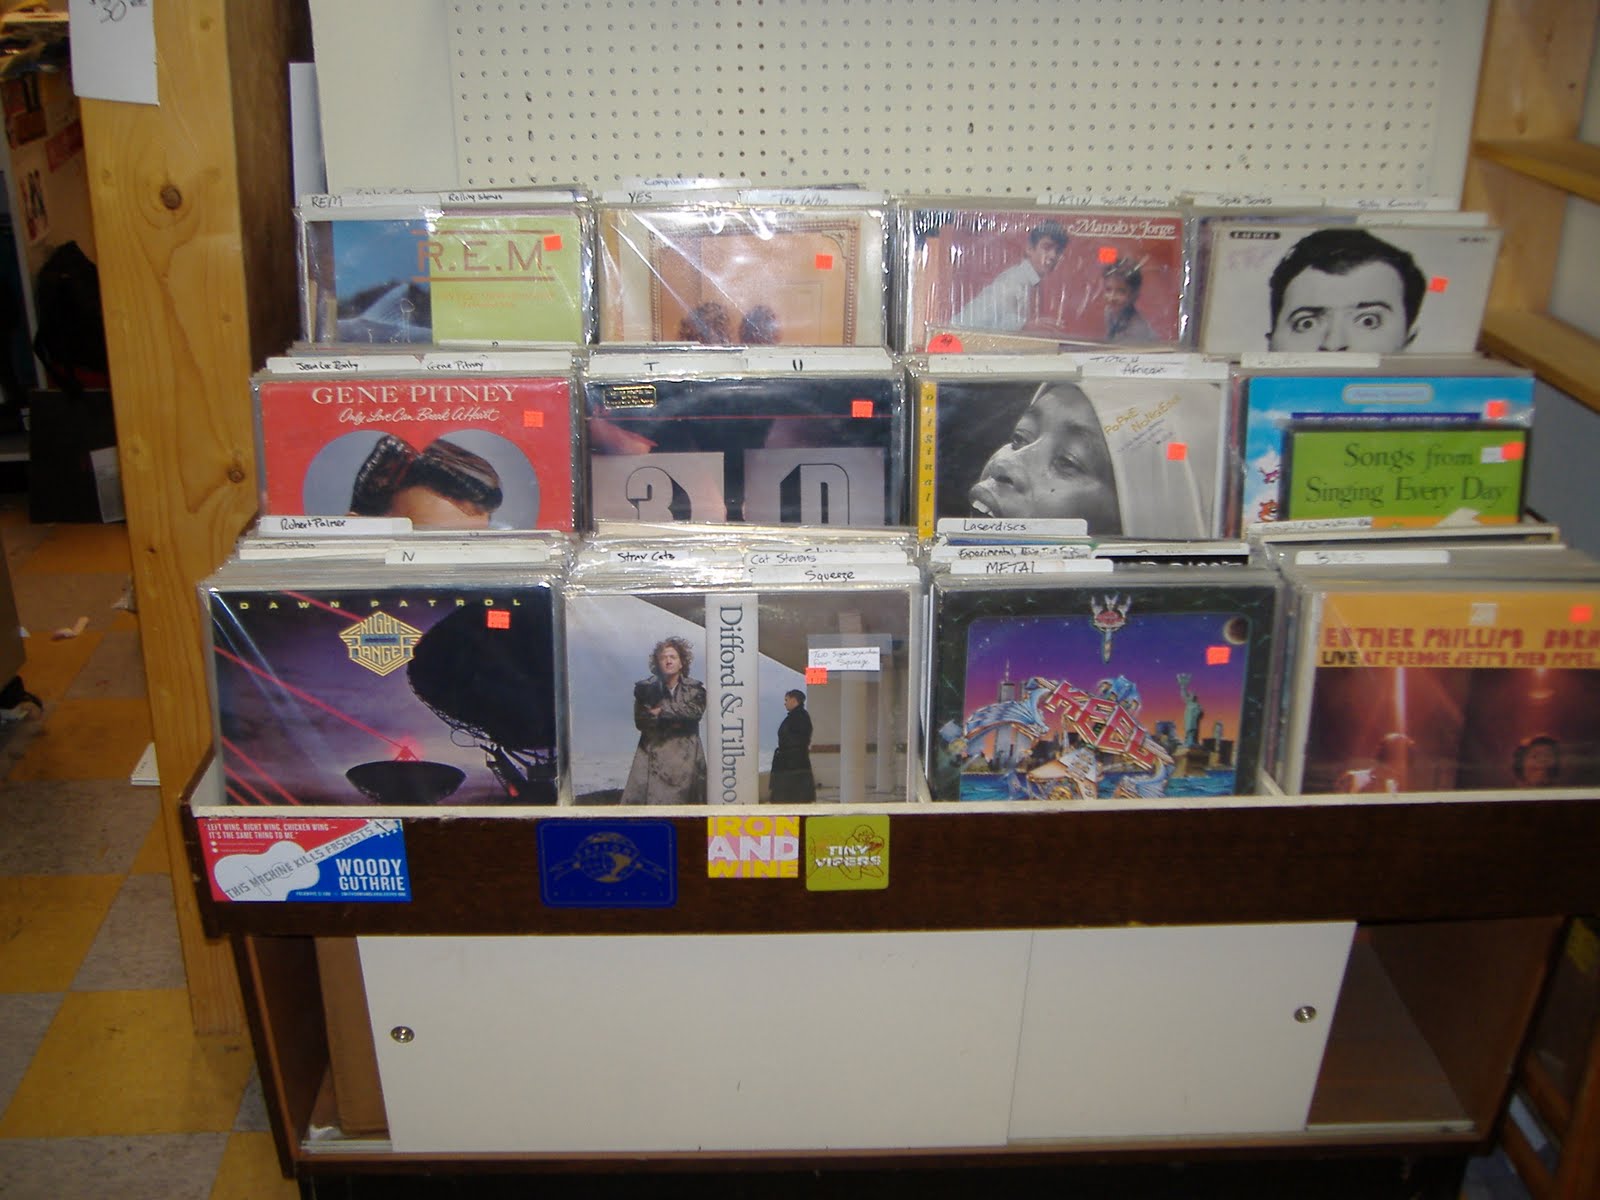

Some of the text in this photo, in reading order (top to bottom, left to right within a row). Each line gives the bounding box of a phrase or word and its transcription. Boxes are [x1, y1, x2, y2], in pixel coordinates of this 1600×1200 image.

[312, 196, 342, 208] REM
[628, 192, 653, 203] YES
[1067, 219, 1127, 235] Manolo
[1136, 220, 1177, 239] Jorge
[417, 239, 555, 272] R.E.M.
[427, 362, 452, 371] Gene
[644, 361, 660, 371] T
[792, 359, 803, 371] U
[311, 384, 518, 404] GENE PITNEY
[339, 408, 367, 425] Only
[367, 410, 391, 423] Love
[392, 408, 413, 423] Can
[417, 408, 449, 422] Break
[464, 407, 500, 422] Heart
[1344, 442, 1474, 471] Songs from
[1305, 476, 1511, 509] Singing Every Day
[281, 518, 347, 531] Robert Palmer
[963, 519, 1027, 532] Laserdiscs
[402, 551, 415, 562] N
[750, 554, 817, 565] Cat Stevens
[985, 561, 1043, 574] METAL
[804, 570, 856, 585] Squeeze
[240, 599, 521, 610] DAWN PATROL
[361, 612, 401, 634] NIGHT
[348, 645, 415, 665] RANGER
[1321, 651, 1358, 665] LIVE
[720, 604, 745, 804] Difford & Tilbroo
[283, 823, 311, 831] CHICKEN
[708, 817, 799, 836] IRON
[223, 831, 235, 839] THE
[236, 831, 253, 839] SAME
[254, 831, 274, 839] THING
[275, 831, 283, 839] TO
[708, 836, 799, 861] AND
[828, 845, 871, 857] TINY
[225, 828, 374, 898] THIS MACHINE KILLS FASCISTS
[335, 858, 402, 876] WOODY
[708, 860, 799, 878] WINE
[815, 856, 882, 868] VIPERS
[338, 876, 406, 891] GUTHRIE
